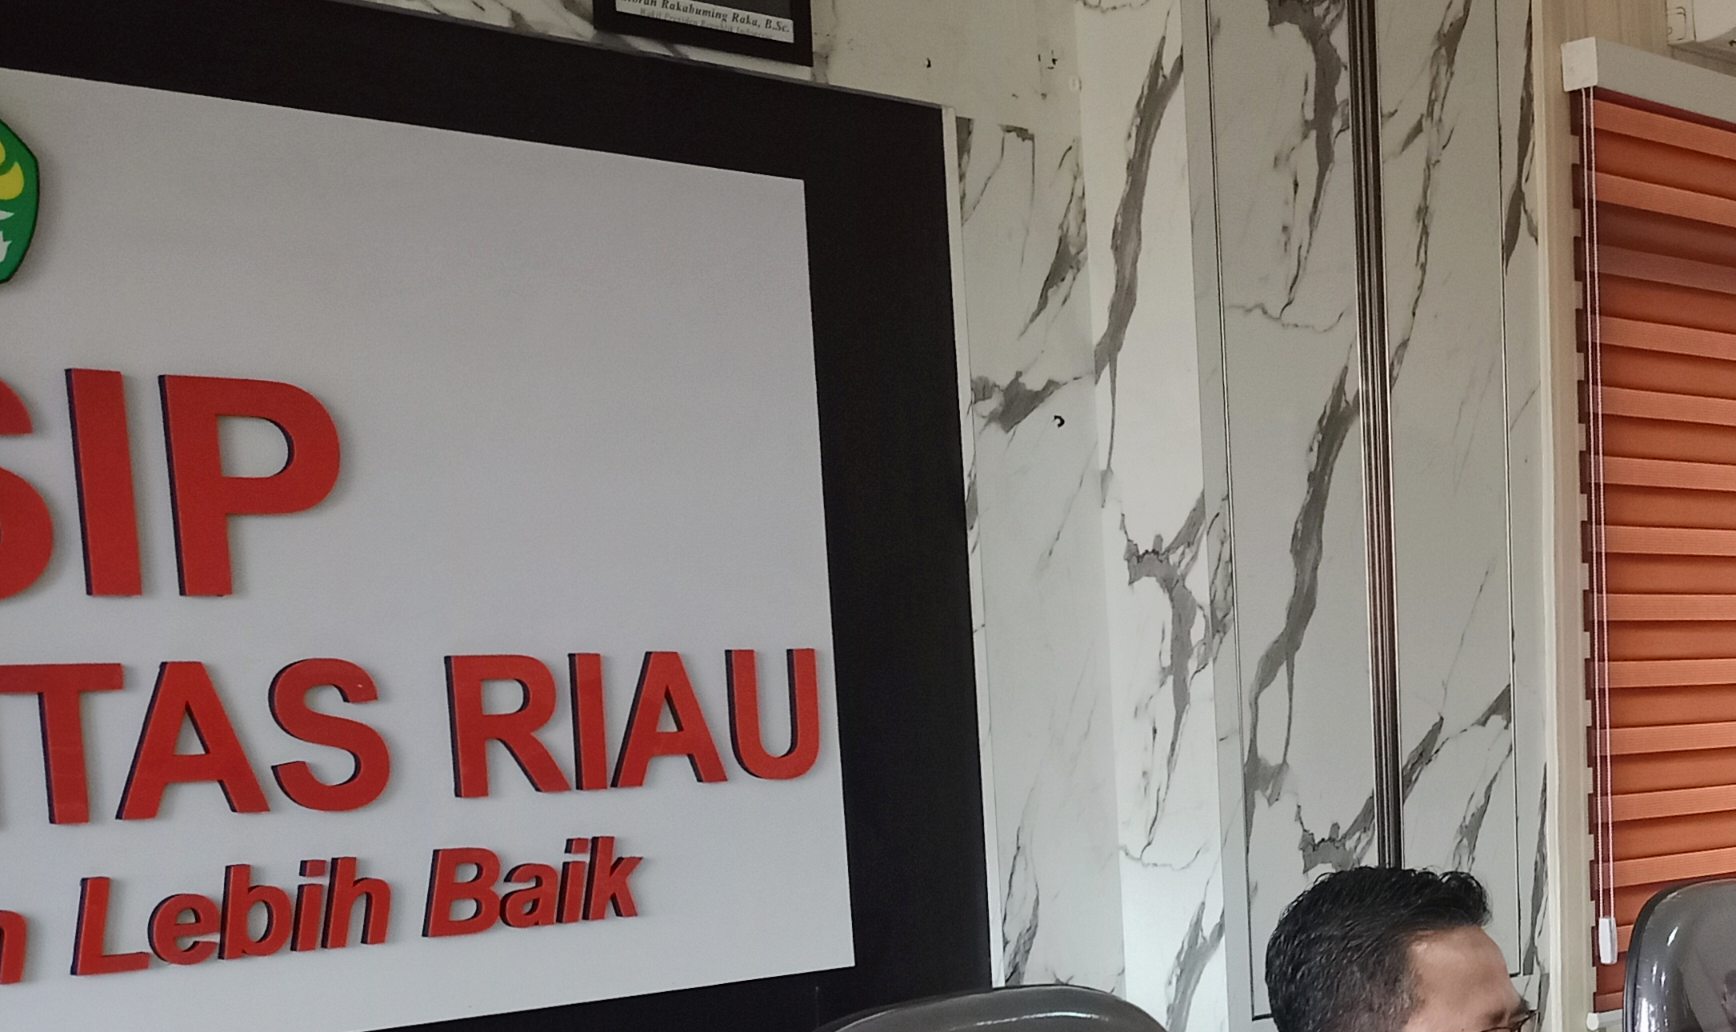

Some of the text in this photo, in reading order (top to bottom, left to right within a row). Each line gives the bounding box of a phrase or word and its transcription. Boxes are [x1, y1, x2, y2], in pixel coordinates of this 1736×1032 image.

[731, 12, 761, 28] Raka,
[443, 648, 820, 798] RIAU
[70, 855, 391, 975] Lebih
[421, 836, 643, 938] Baik
